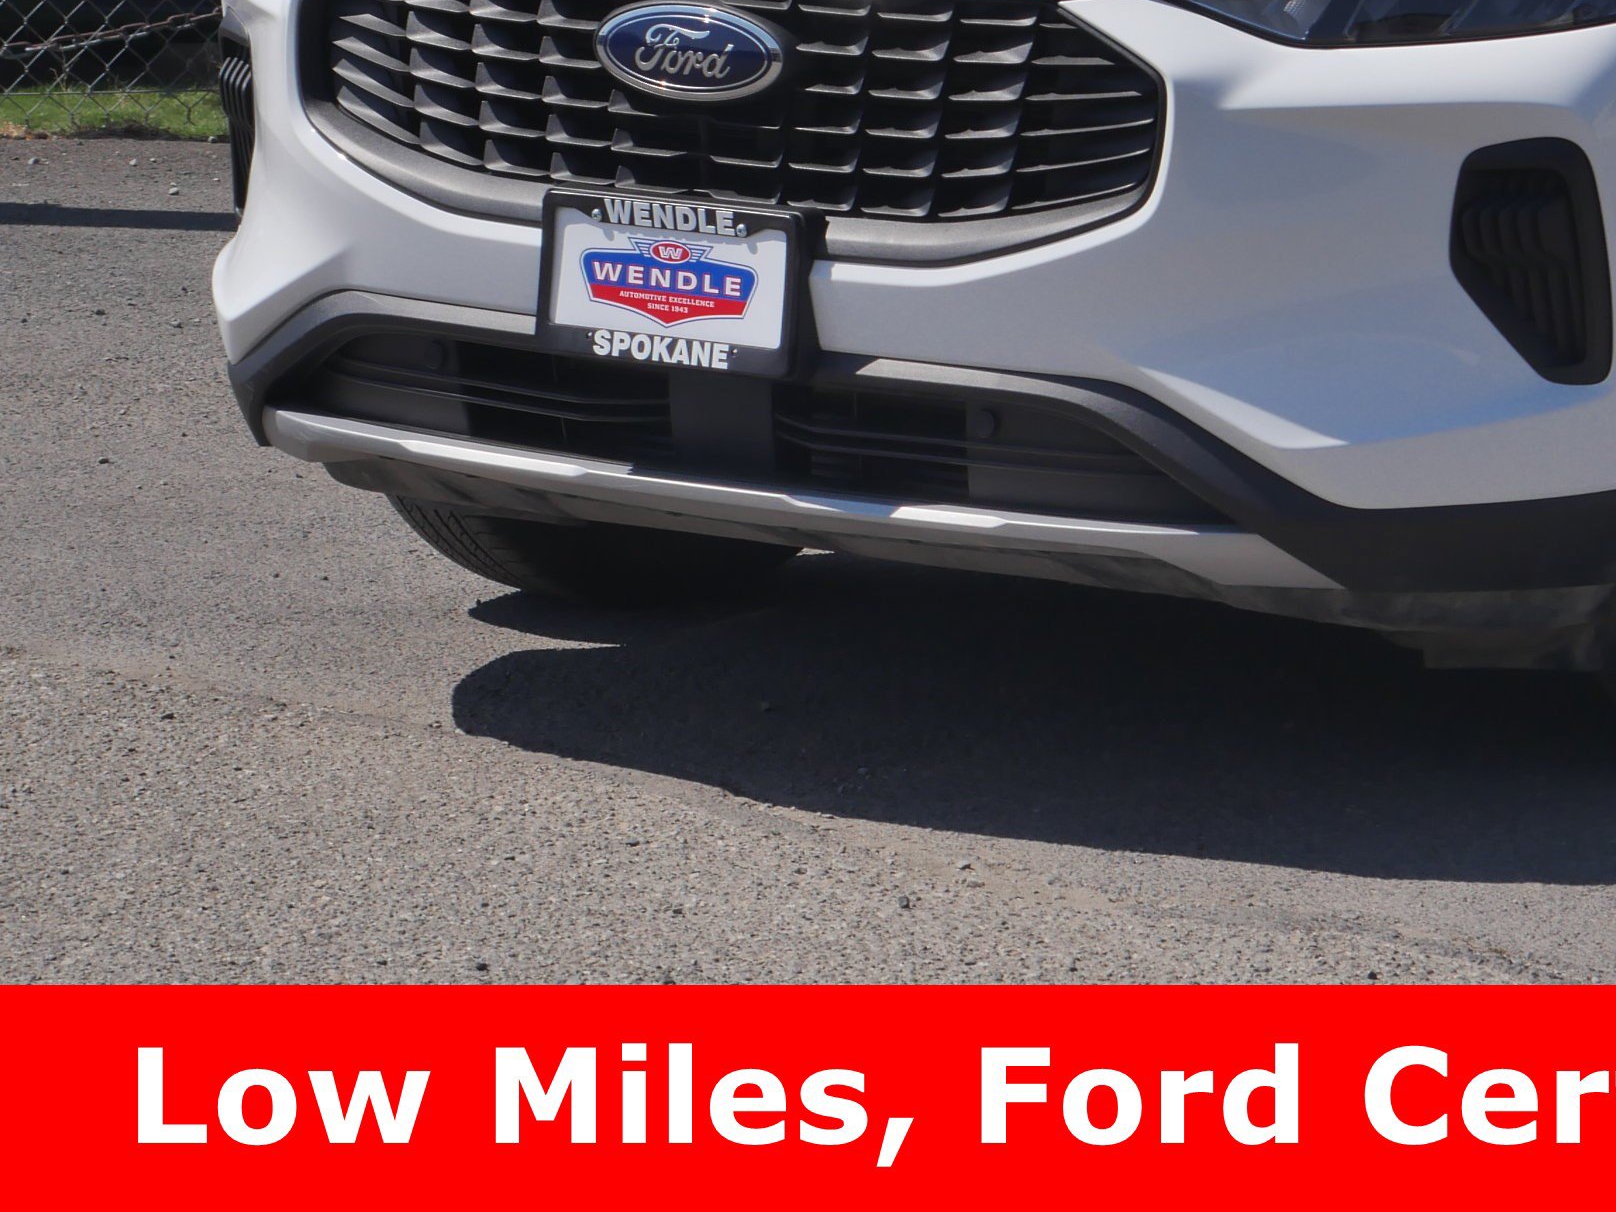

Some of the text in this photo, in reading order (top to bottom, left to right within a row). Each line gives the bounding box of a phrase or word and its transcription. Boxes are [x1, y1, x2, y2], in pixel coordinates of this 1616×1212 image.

[634, 23, 735, 79] Ford
[603, 198, 736, 237] WENDLE
[592, 261, 742, 297] WENDLE
[619, 290, 715, 308] AUTOMOTIVE EXCELLENCE
[647, 302, 689, 314] SINCE 1943
[592, 328, 730, 370] SPOKANE
